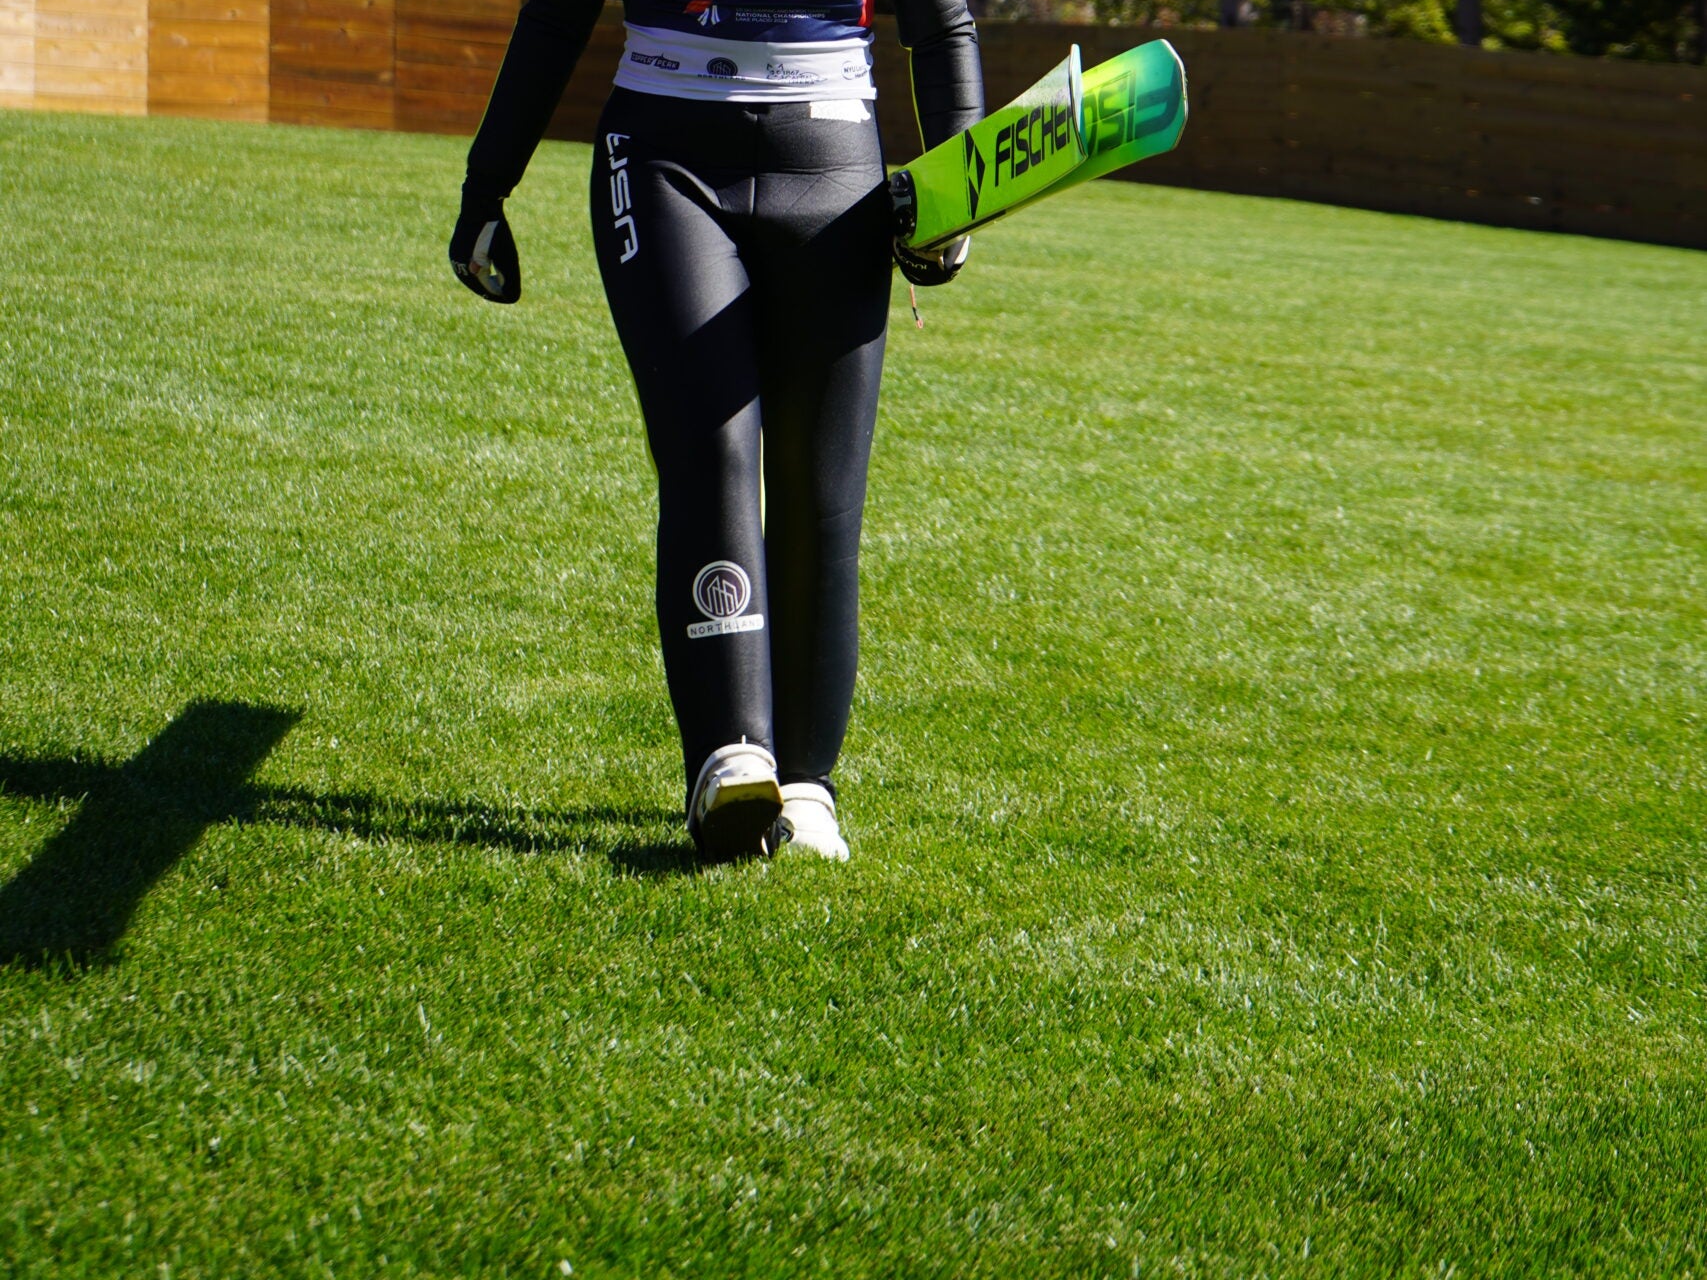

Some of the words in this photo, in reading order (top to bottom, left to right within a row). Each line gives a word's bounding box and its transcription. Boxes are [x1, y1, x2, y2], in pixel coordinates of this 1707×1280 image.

[735, 11, 770, 19] NATIONAL
[657, 59, 678, 69] PEAK
[606, 132, 639, 264] USA
